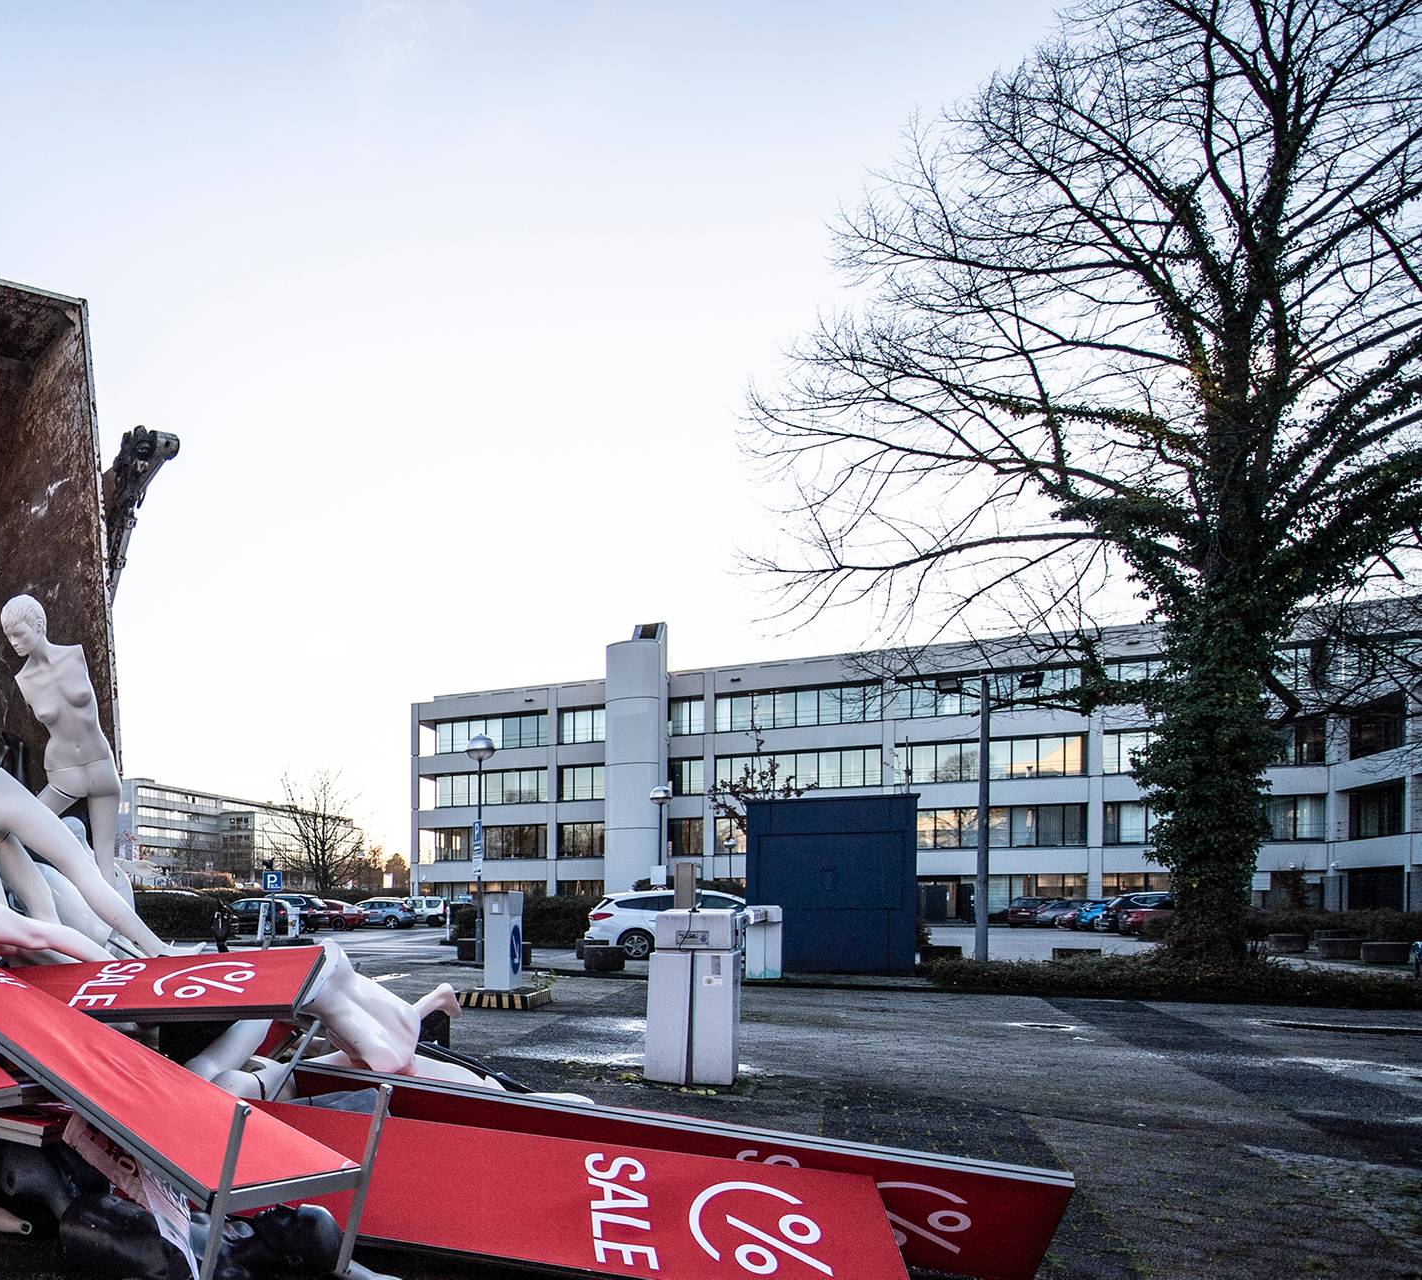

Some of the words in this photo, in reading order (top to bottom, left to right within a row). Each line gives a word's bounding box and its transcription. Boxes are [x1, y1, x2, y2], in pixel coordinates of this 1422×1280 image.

[267, 874, 278, 889] P
[67, 962, 147, 1007] SALE
[584, 1152, 660, 1271] SALE
